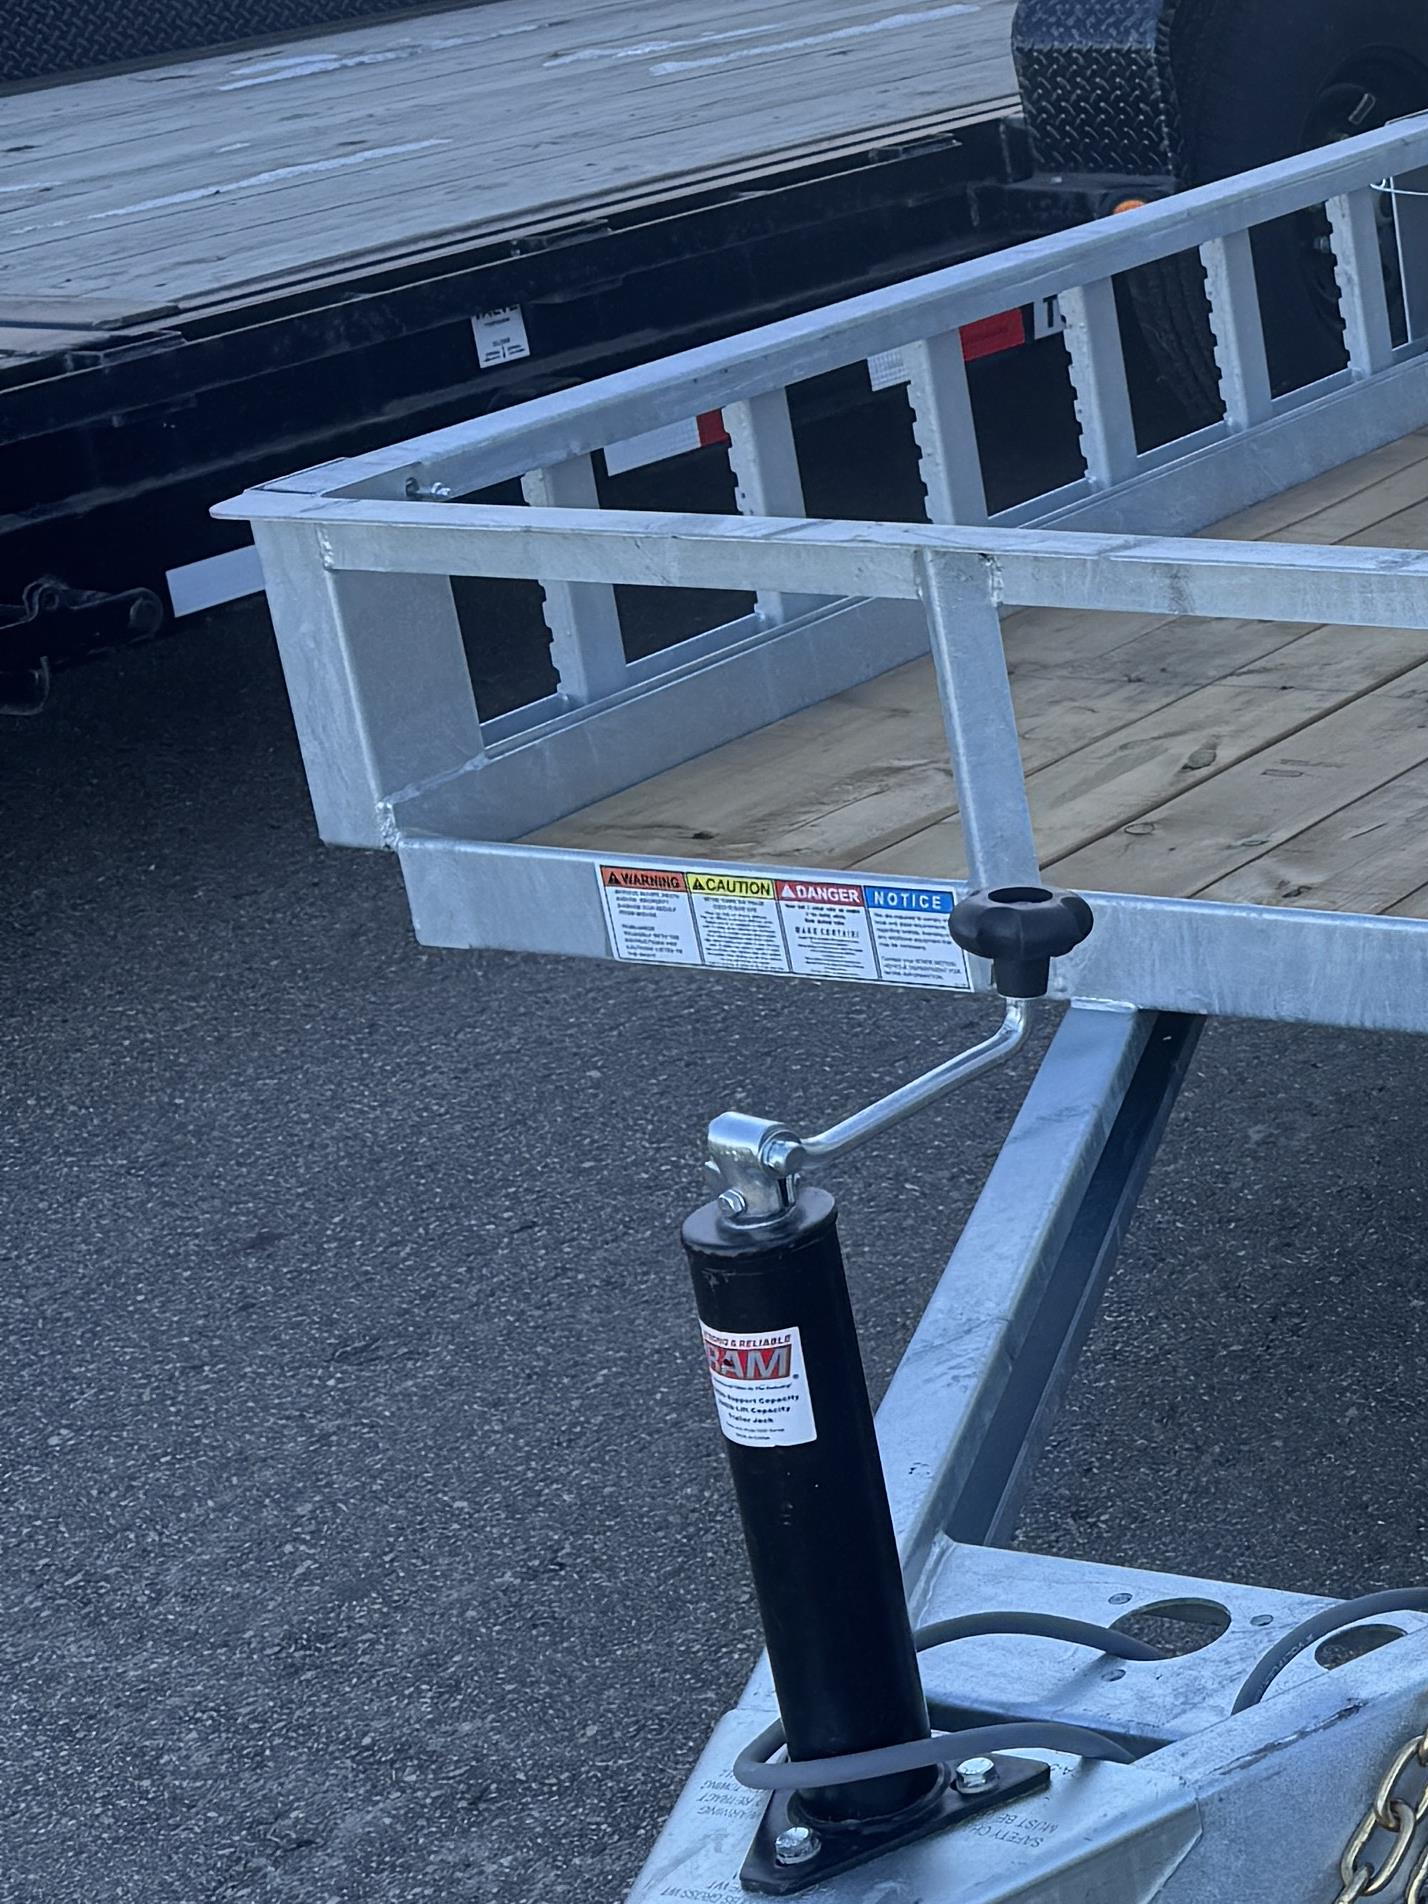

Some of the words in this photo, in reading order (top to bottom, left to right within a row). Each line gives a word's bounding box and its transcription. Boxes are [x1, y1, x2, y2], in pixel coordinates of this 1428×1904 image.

[621, 872, 681, 889] WARNING
[706, 878, 770, 896] CAUTION
[796, 885, 861, 903] DANGER
[874, 890, 942, 909] NOTICE
[707, 1345, 787, 1380] RAM
[991, 1829, 1044, 1848] SAFETY
